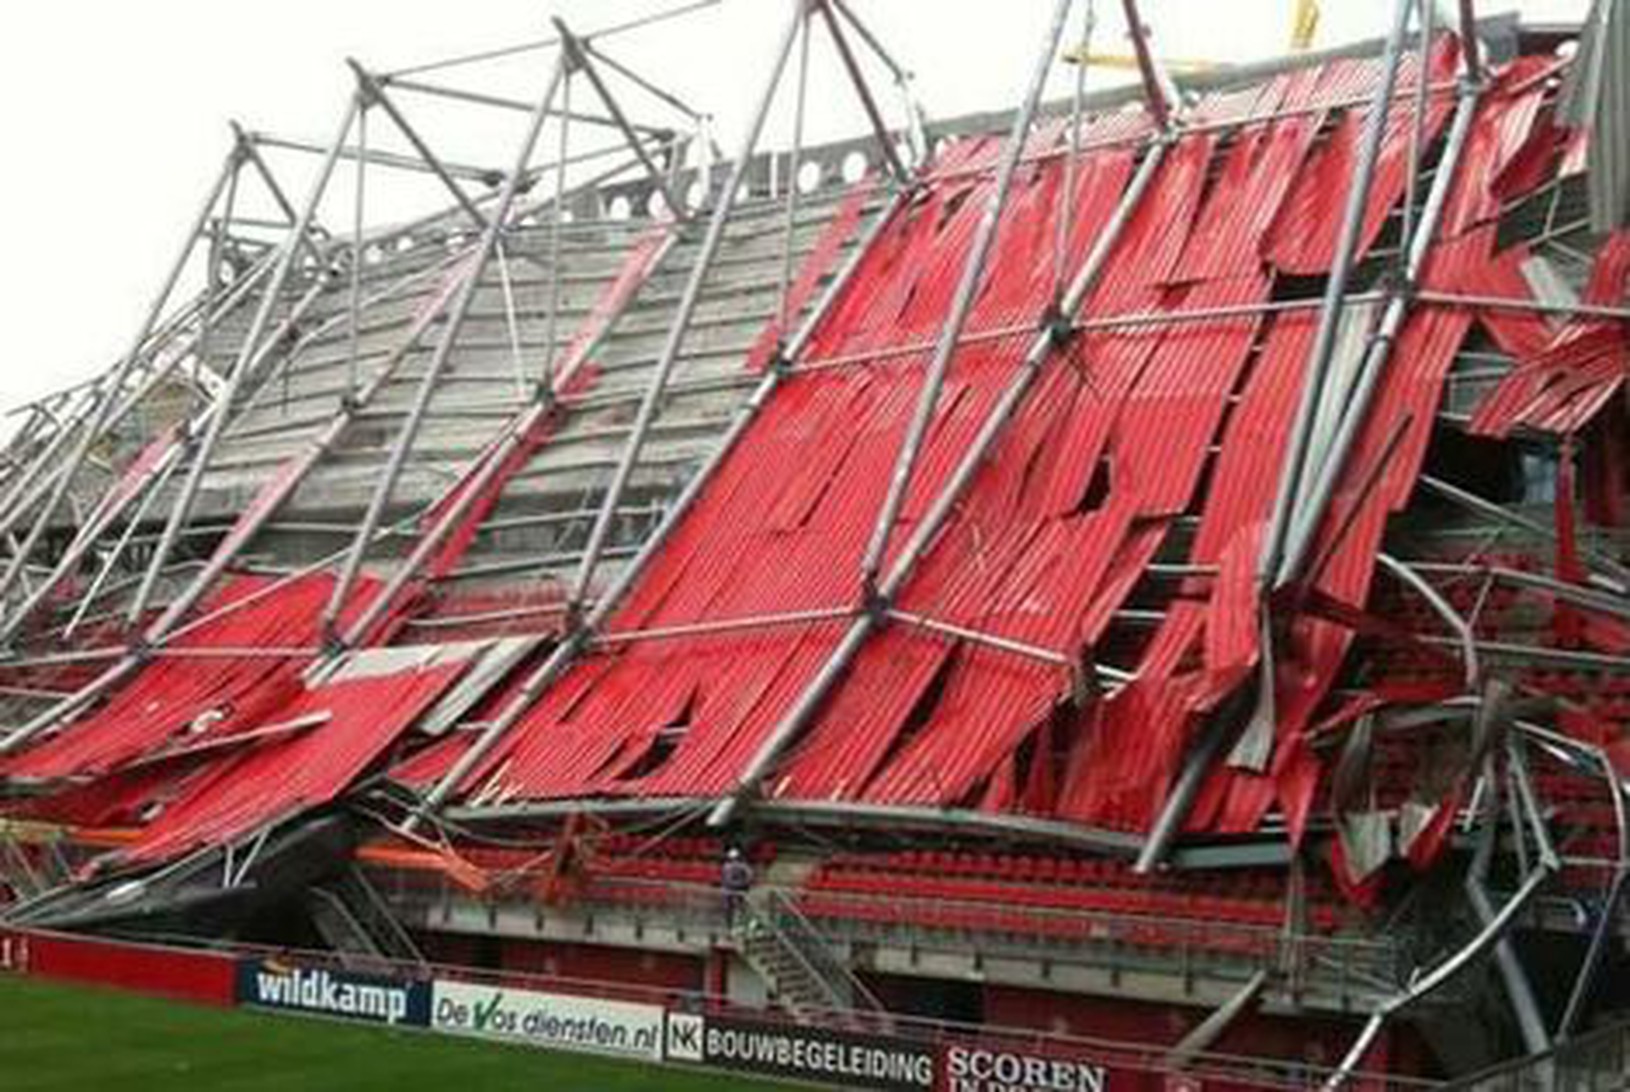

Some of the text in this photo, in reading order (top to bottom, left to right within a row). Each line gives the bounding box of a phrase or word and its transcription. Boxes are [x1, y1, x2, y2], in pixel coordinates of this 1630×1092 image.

[257, 970, 407, 1024] wildkamp
[437, 998, 468, 1022] De
[706, 1028, 933, 1085] BOUWBEGELEIDING
[946, 1046, 1105, 1092] SCOREN
